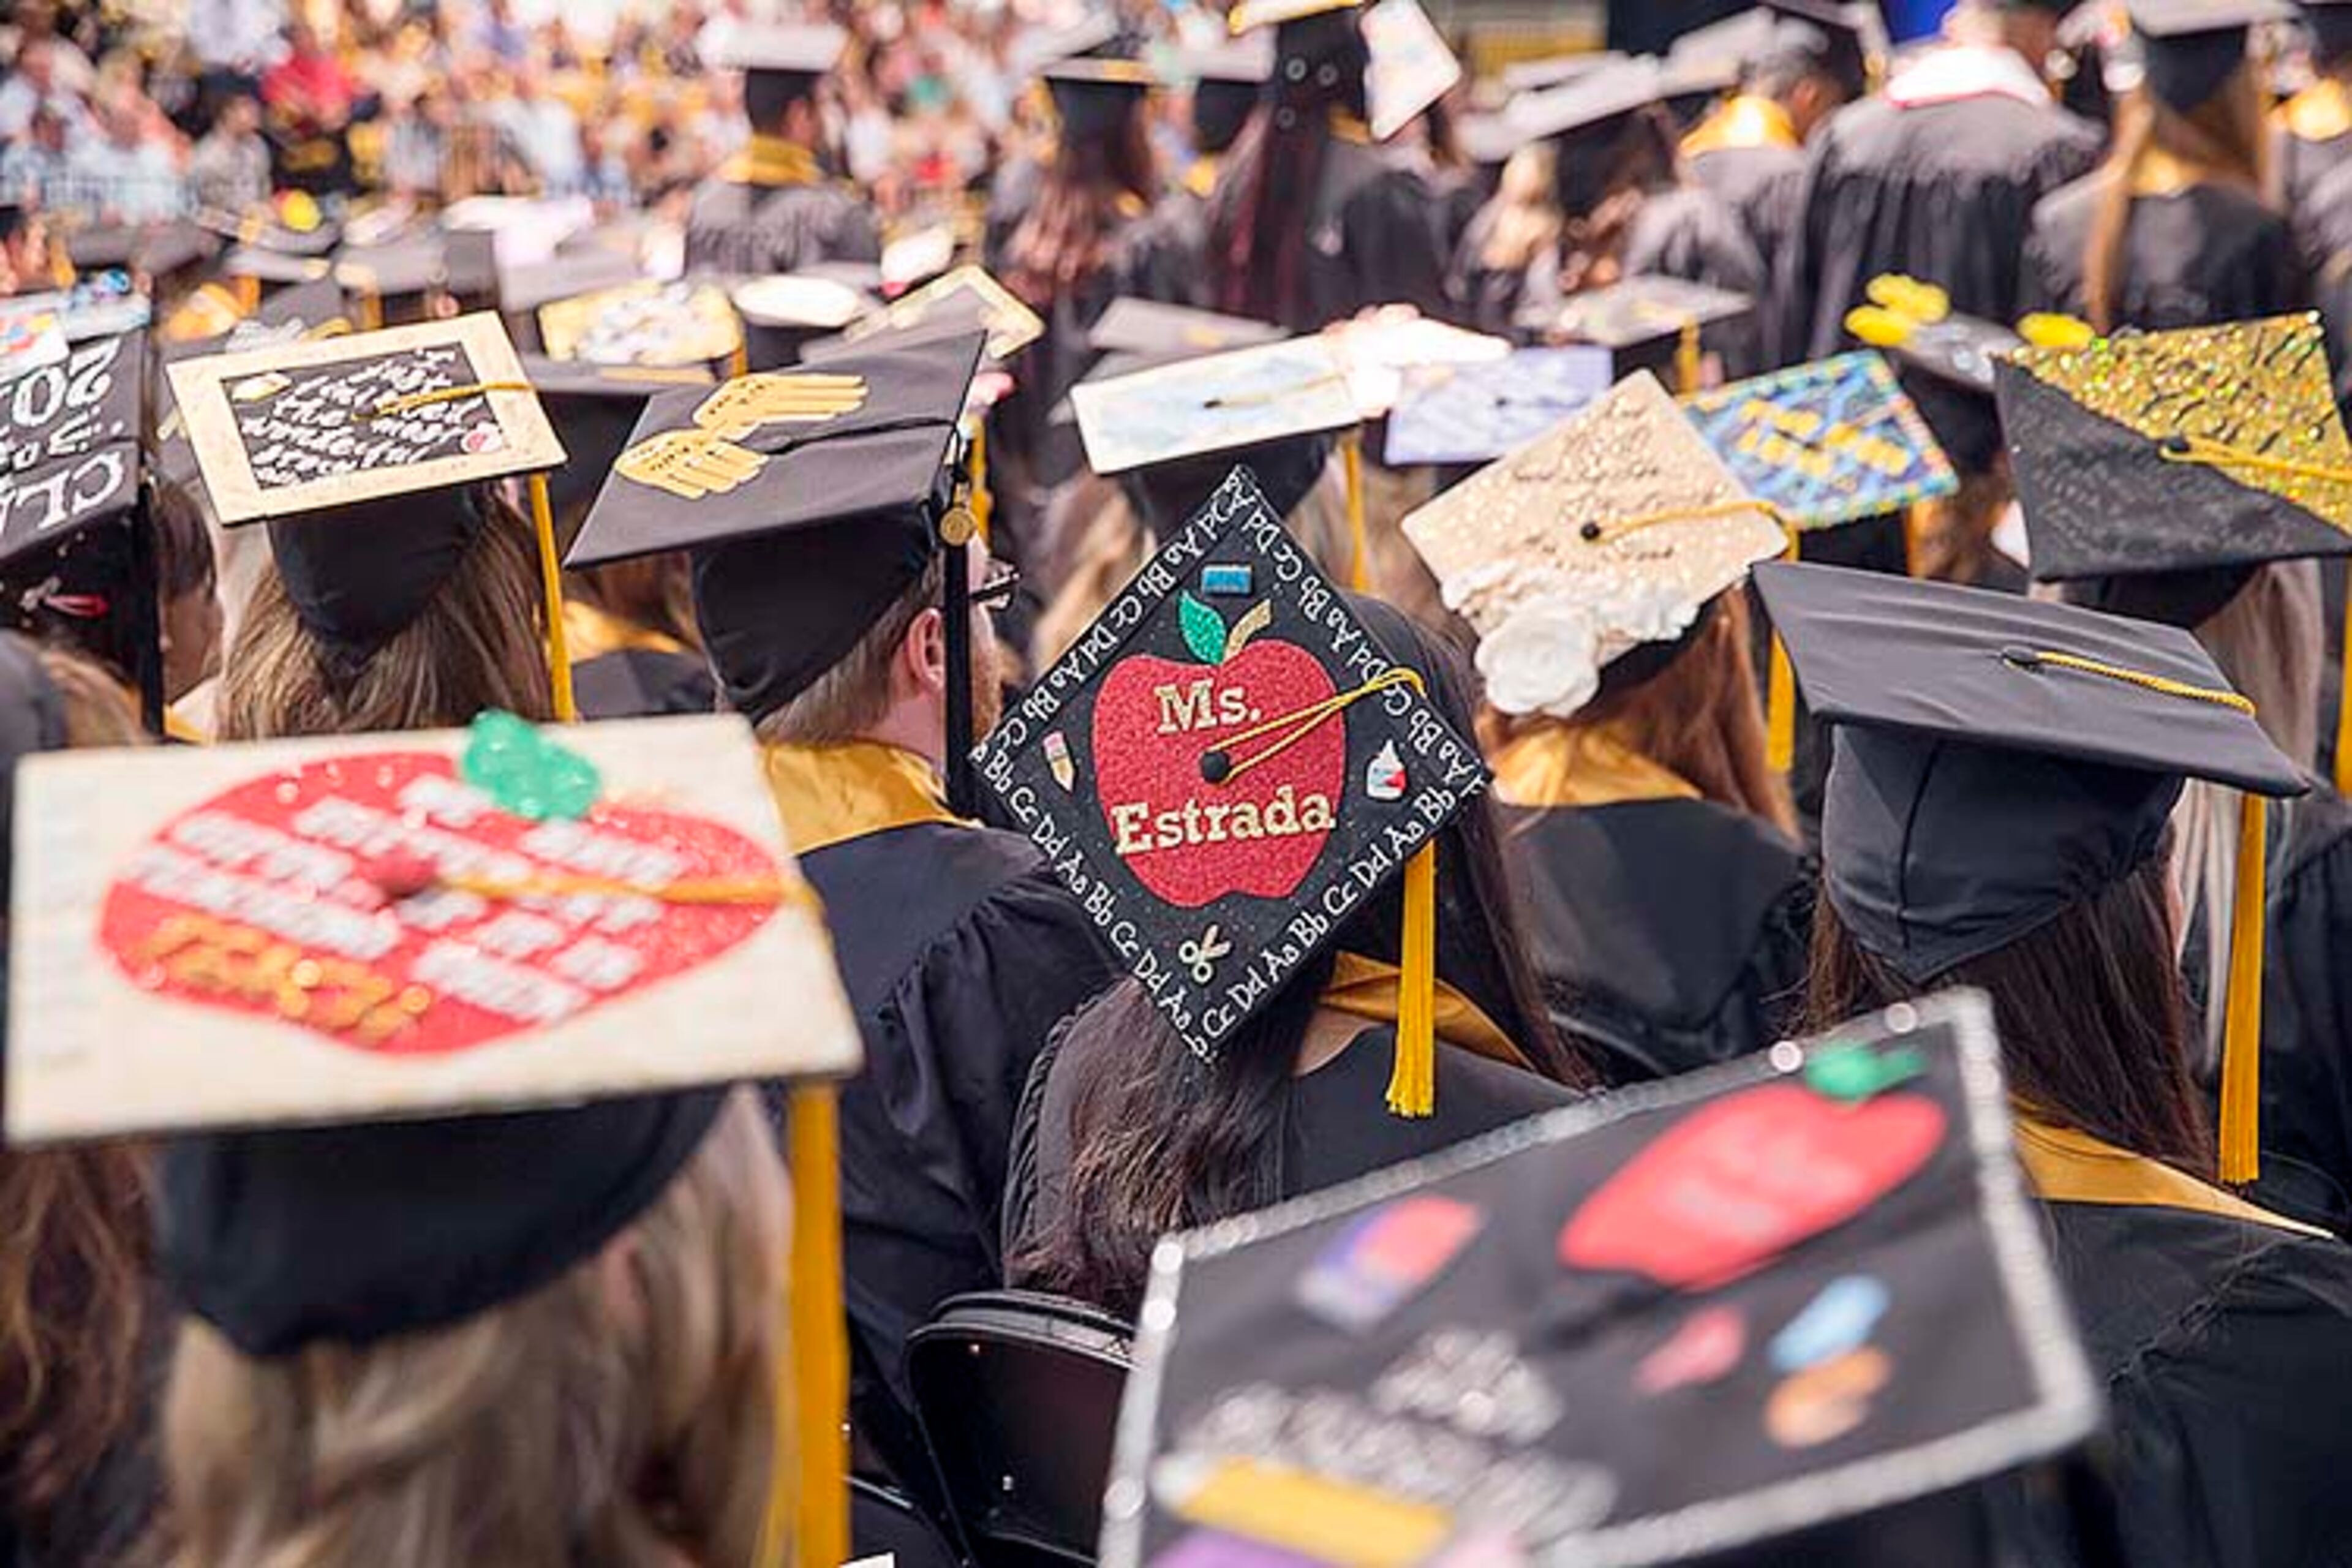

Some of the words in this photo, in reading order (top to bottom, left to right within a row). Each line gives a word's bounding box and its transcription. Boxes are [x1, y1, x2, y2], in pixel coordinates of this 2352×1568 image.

[1164, 527, 1204, 564] Aa
[1242, 510, 1280, 553] Dd
[1137, 562, 1175, 597] Bb
[1273, 543, 1302, 581] Cc
[1110, 596, 1141, 627] Cc
[1298, 576, 1330, 620] Bb
[1079, 624, 1118, 665] Dd
[1327, 608, 1361, 652] Aa
[1050, 651, 1085, 687] Aa
[1022, 686, 1060, 720] Bb
[1154, 678, 1262, 734] Ms.
[996, 719, 1027, 748] Cc
[1408, 709, 1442, 755] Bb
[1439, 741, 1474, 784] Aa
[1110, 784, 1336, 854] Estrada
[984, 748, 1013, 793] Bb
[1011, 787, 1038, 823] Cc
[1032, 817, 1069, 858] Dd
[1055, 851, 1087, 894] Aa
[1084, 881, 1115, 925] Bb
[1110, 922, 1139, 957] Cc
[1133, 951, 1171, 994] Dd
[1158, 987, 1191, 1030] Aa
[1203, 1005, 1235, 1037] Cc
[1227, 969, 1267, 1010] Dd
[1261, 944, 1299, 982] Aa
[1288, 912, 1329, 947] Bb
[1324, 882, 1358, 915] Cc
[1350, 846, 1391, 886] Dd
[1384, 821, 1424, 858] Aa
[1414, 787, 1455, 824] Bb
